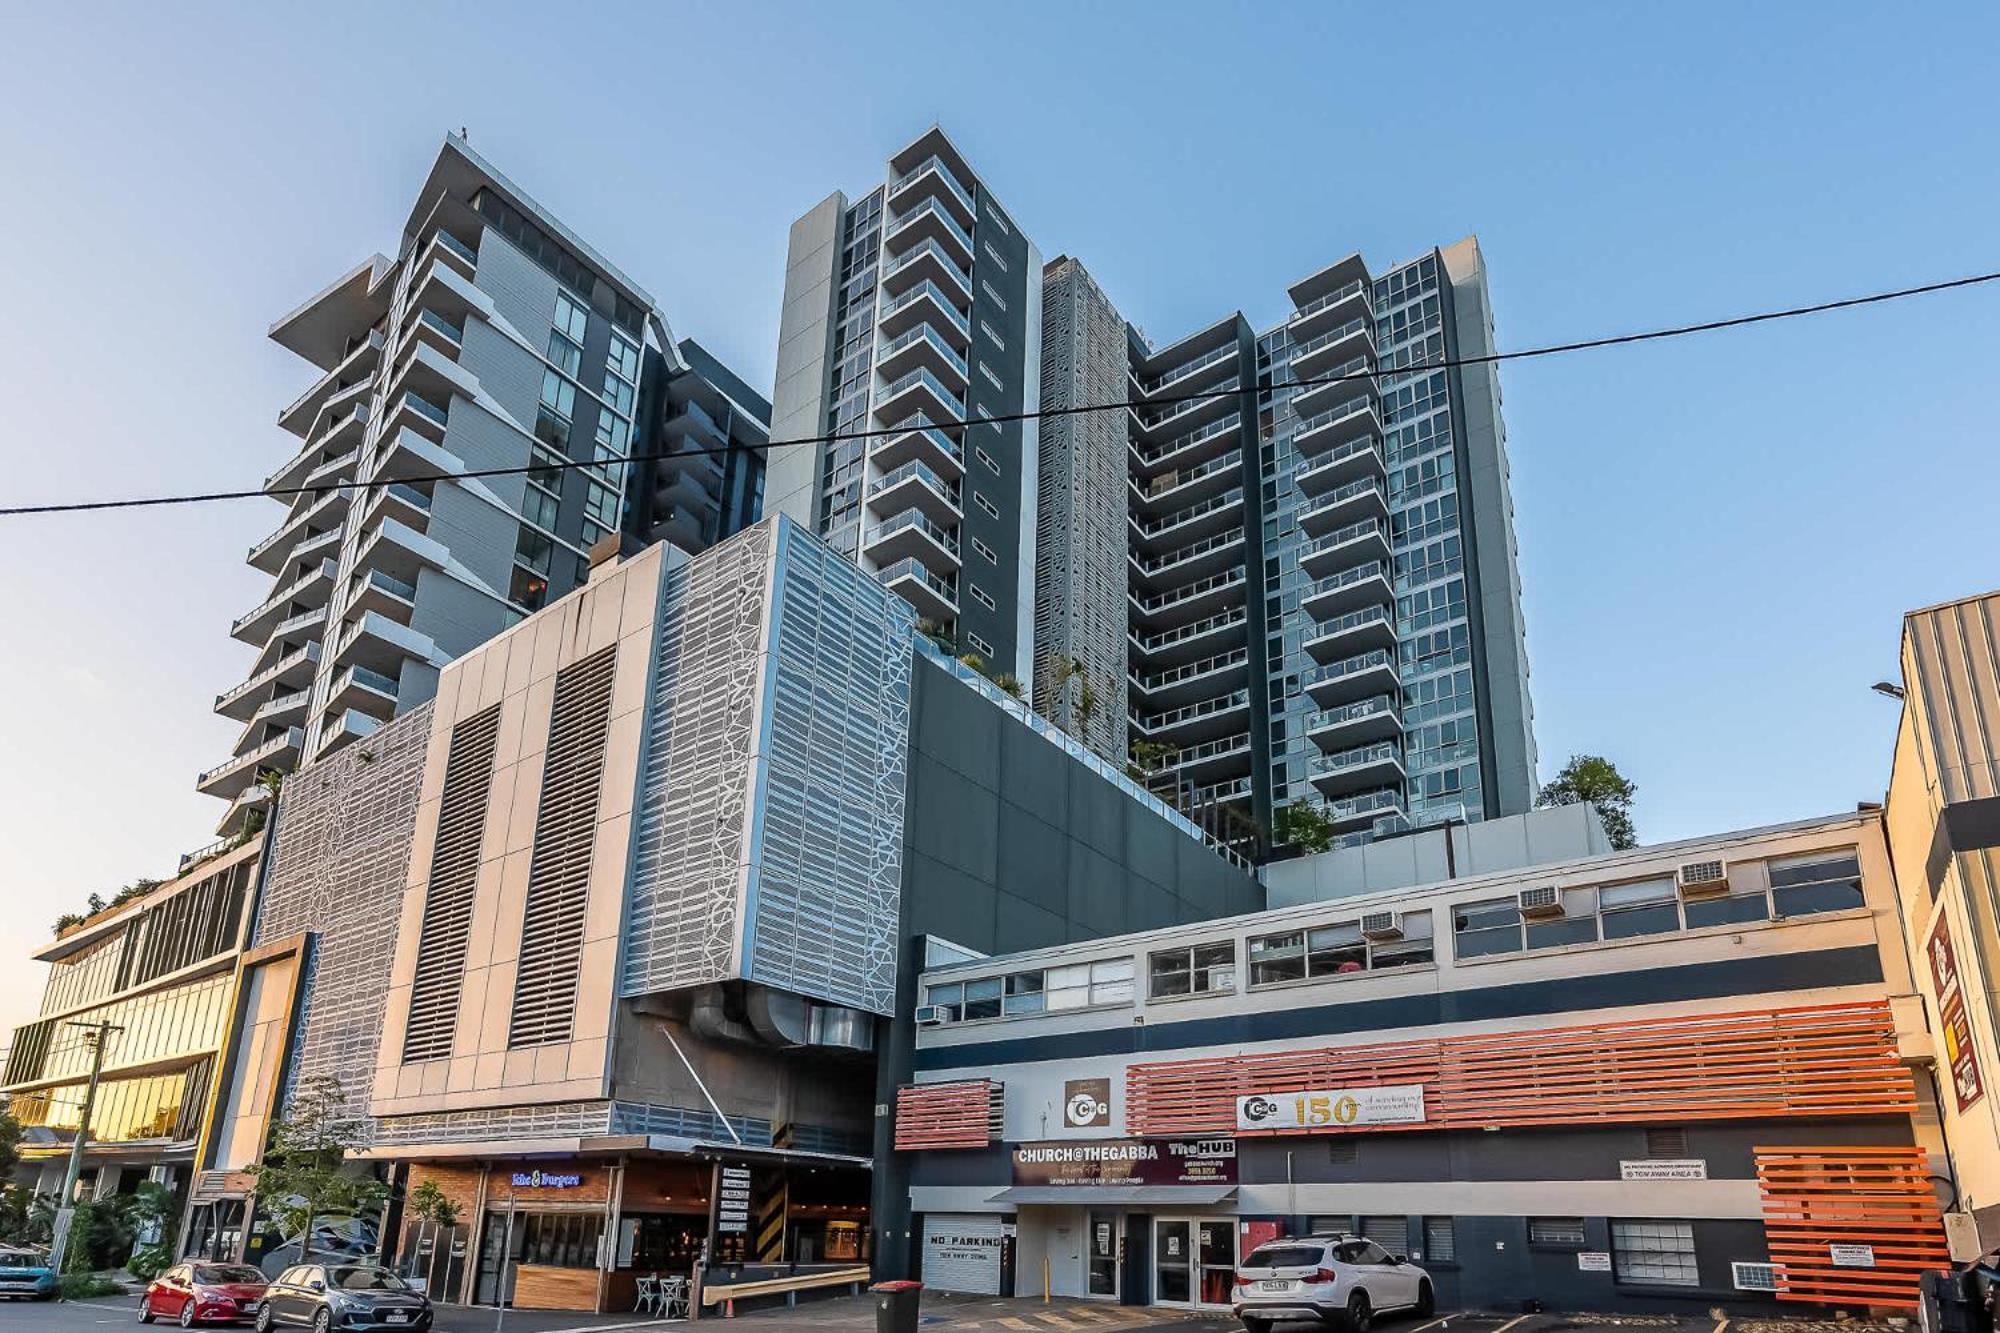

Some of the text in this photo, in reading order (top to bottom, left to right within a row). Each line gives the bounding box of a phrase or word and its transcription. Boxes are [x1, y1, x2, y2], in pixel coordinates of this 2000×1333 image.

[1296, 1096, 1358, 1124] 150
[1019, 1145, 1158, 1162] CHURCH@THEGABBA
[931, 1236, 1000, 1247] NO PARKING
